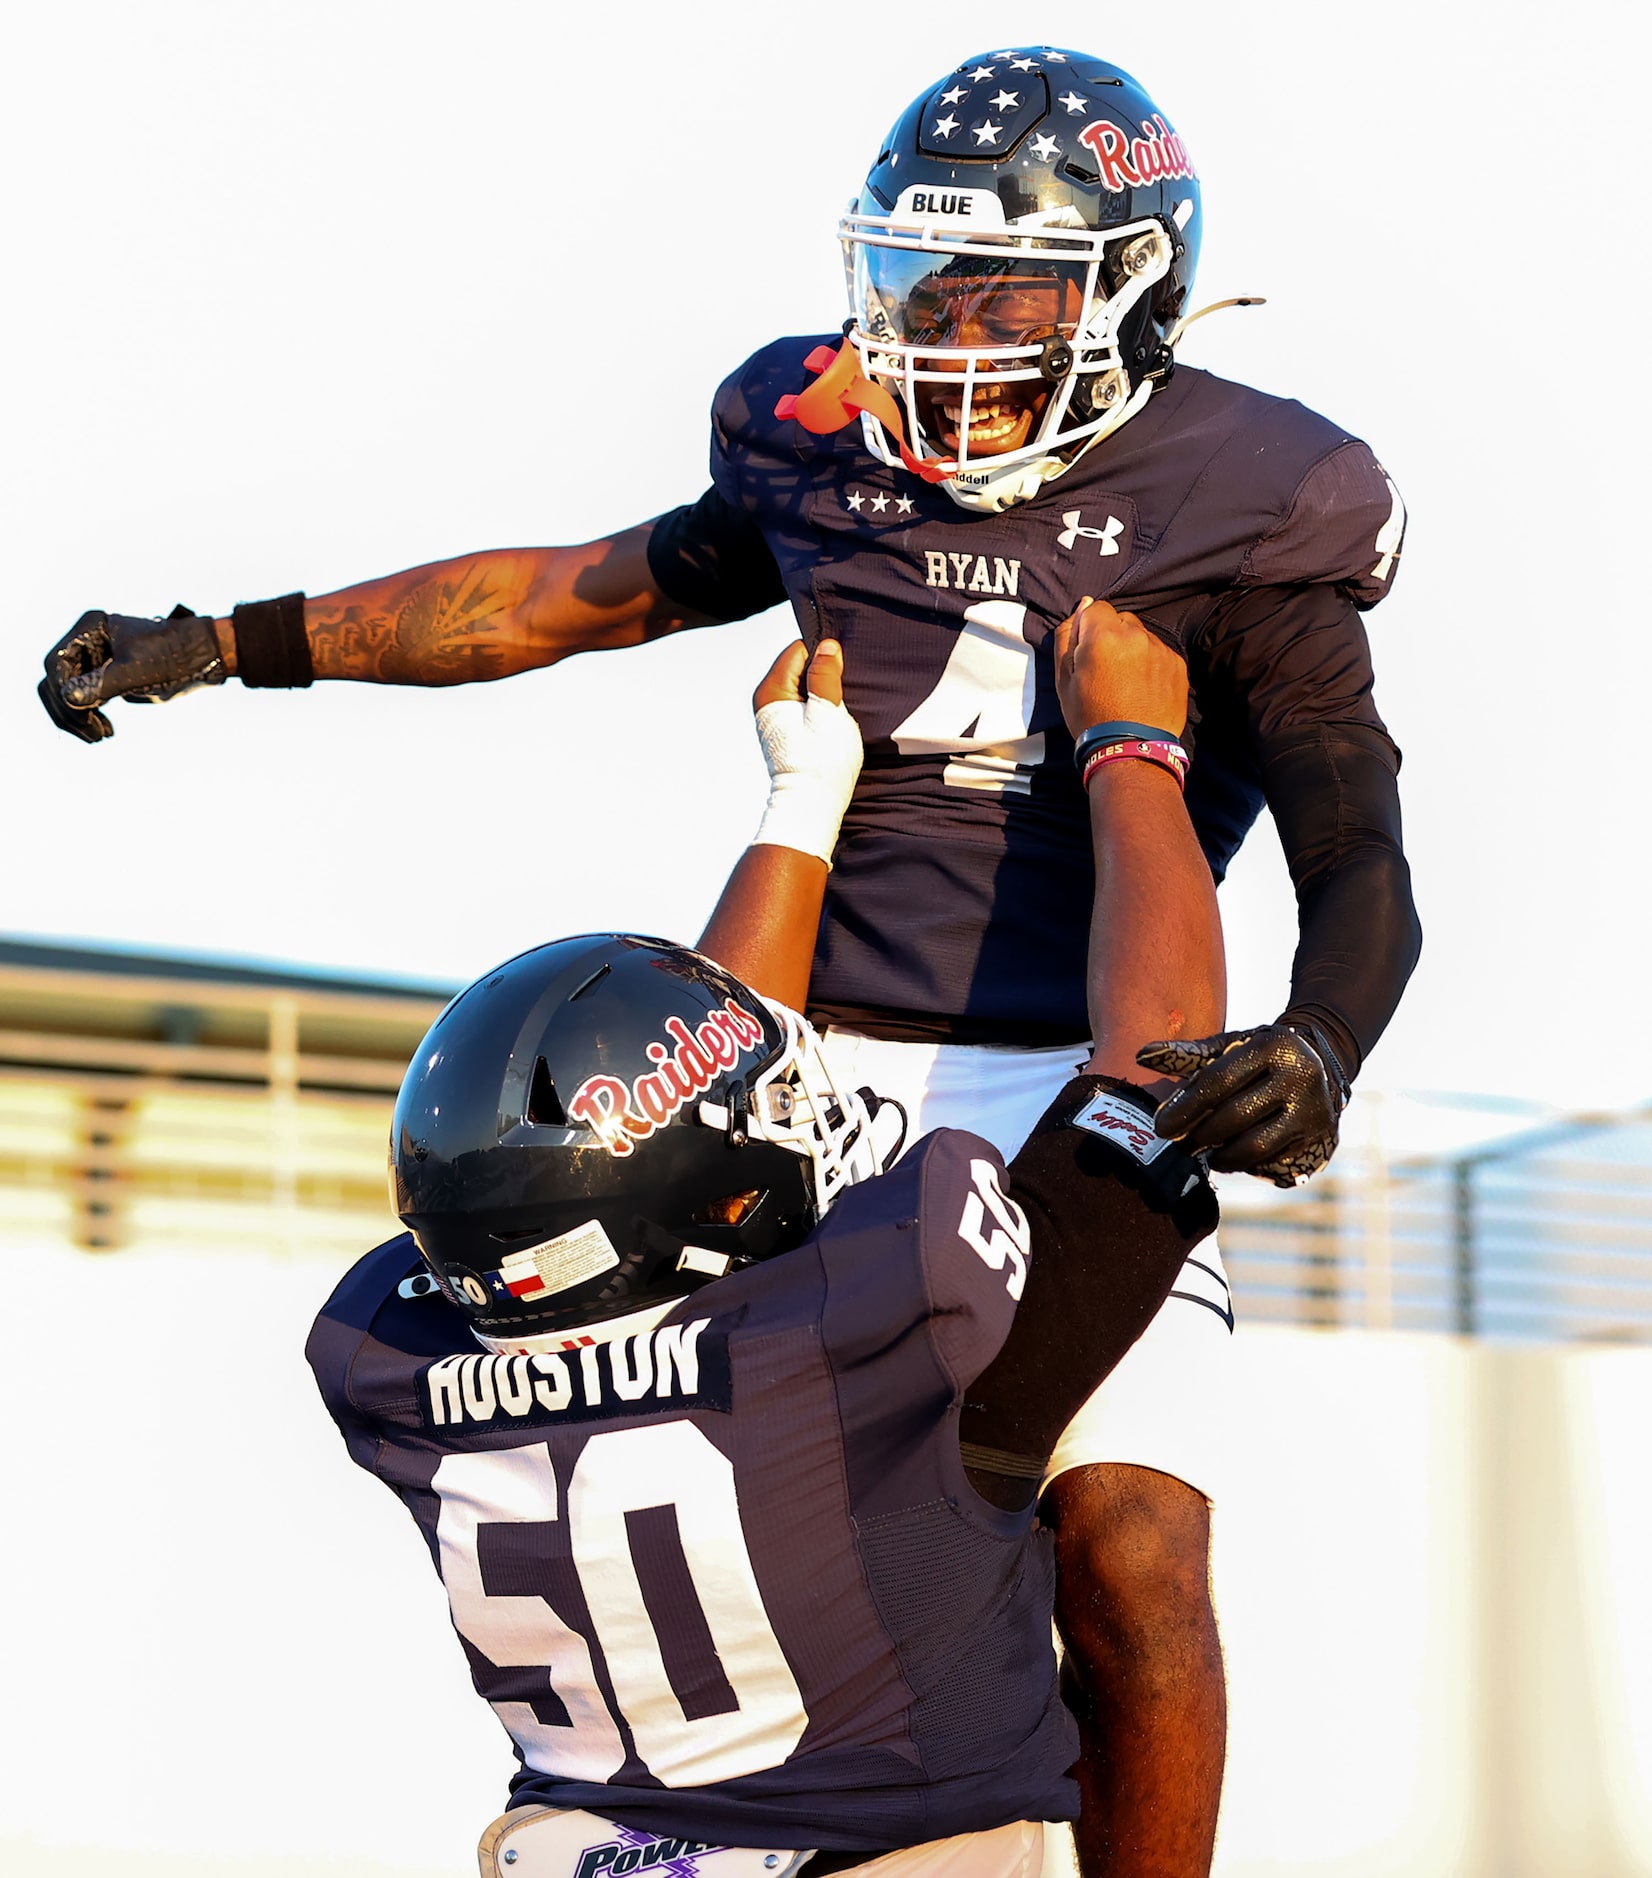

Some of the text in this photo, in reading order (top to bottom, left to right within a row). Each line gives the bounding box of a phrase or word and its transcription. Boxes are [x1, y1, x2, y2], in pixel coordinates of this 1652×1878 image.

[1078, 113, 1194, 193] Raide
[912, 193, 973, 215] BLUE
[952, 473, 990, 485] iddell
[924, 551, 1021, 596] RYAN
[890, 600, 1046, 796] 4
[1084, 744, 1124, 770] NOLES
[568, 997, 765, 1157] Raiders
[533, 1238, 569, 1256] WARNING
[957, 1158, 1031, 1302] 50
[448, 1275, 488, 1306] 50
[427, 1317, 712, 1426] HOUSTON
[431, 1418, 810, 1790] 50
[578, 1838, 719, 1878] POWE
